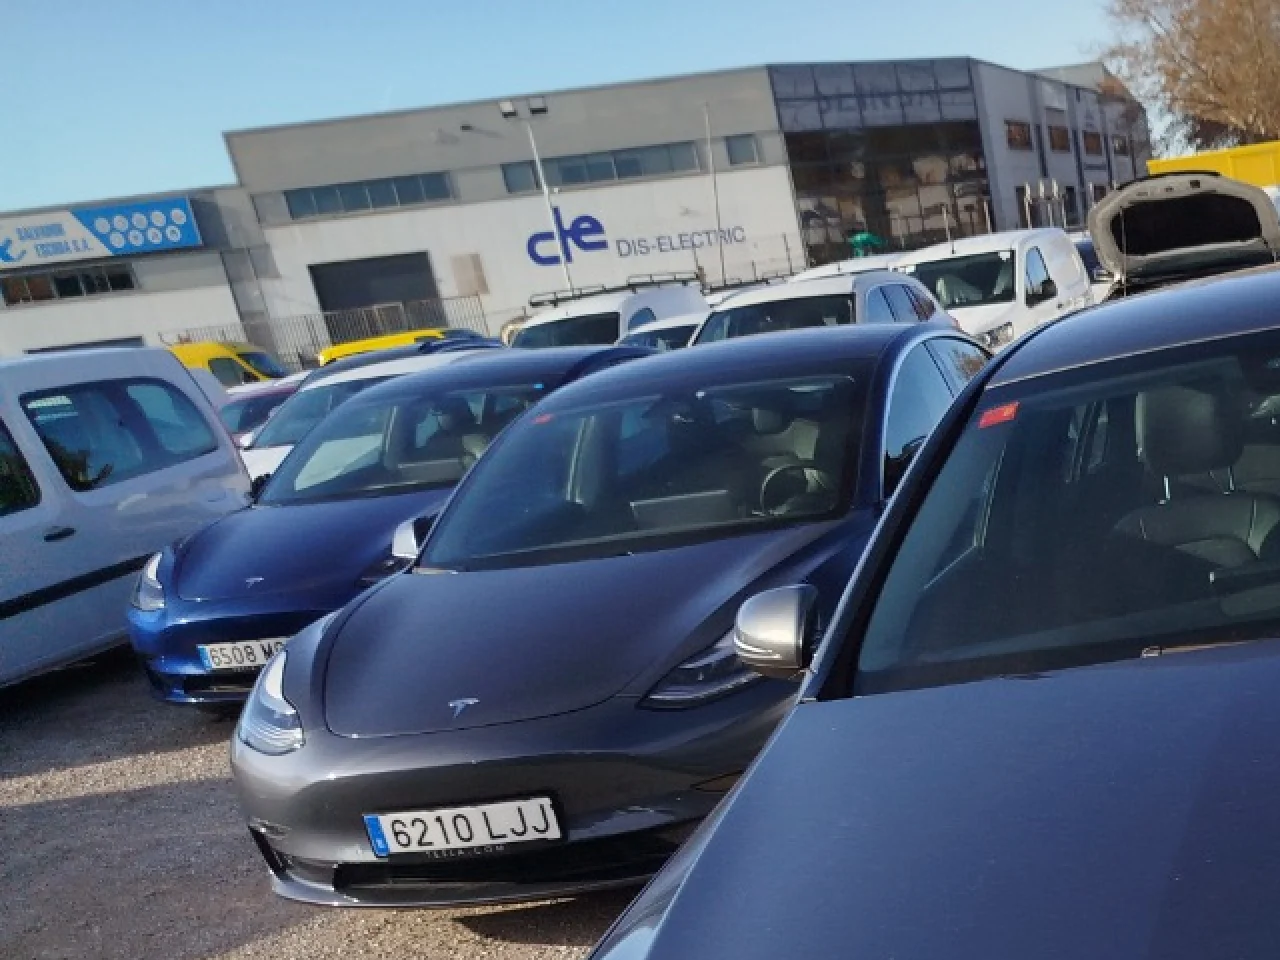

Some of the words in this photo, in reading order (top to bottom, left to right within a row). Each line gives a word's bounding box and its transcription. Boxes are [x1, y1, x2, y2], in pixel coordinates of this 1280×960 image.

[615, 225, 747, 257] DIS-ELECTRIC
[391, 813, 474, 848] 6210
[482, 803, 550, 840] LJJ
